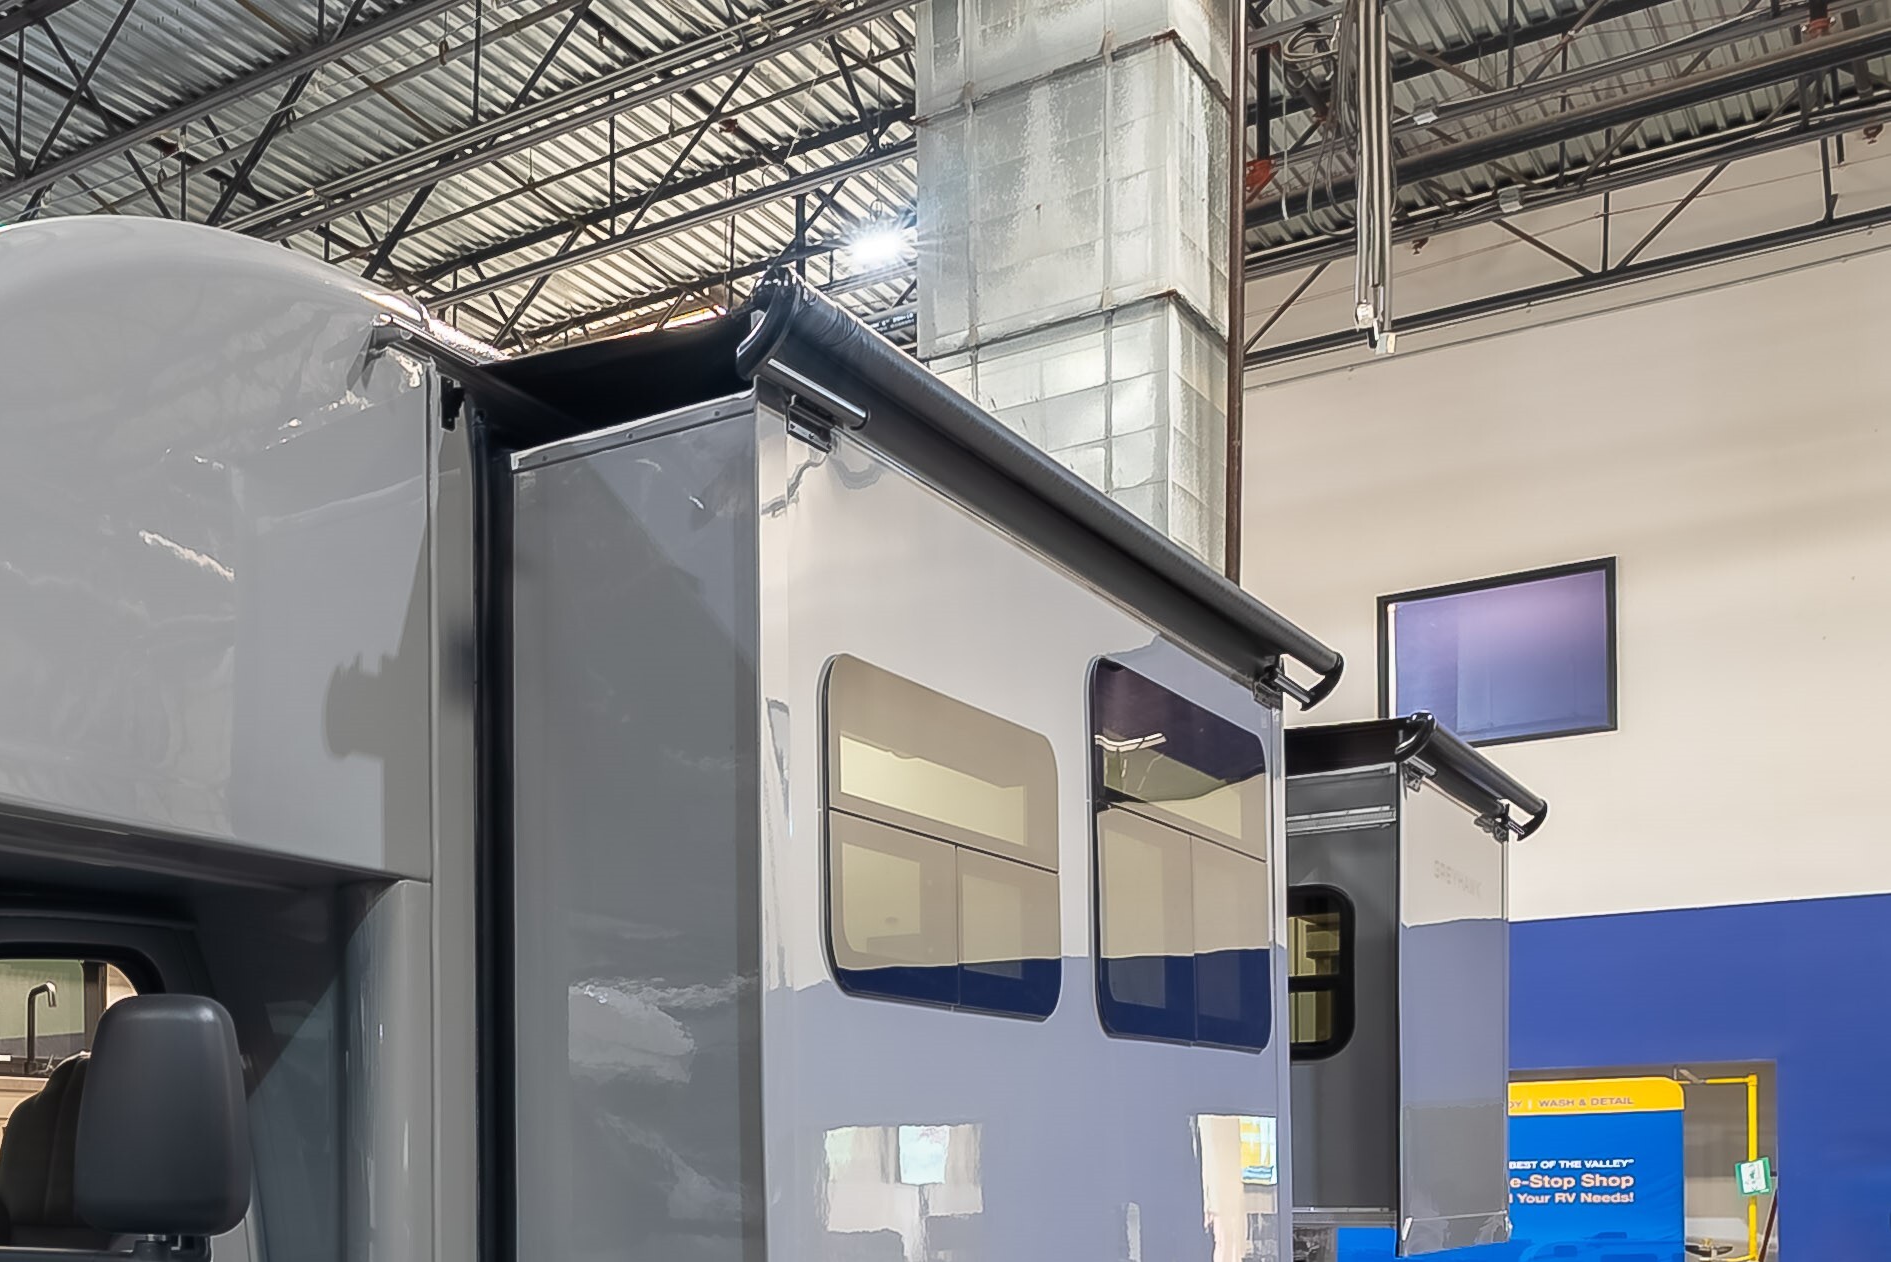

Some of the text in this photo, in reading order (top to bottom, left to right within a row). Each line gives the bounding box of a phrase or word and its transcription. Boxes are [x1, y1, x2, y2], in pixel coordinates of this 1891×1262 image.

[1538, 1099, 1575, 1108] WASH
[1578, 1098, 1586, 1107] &
[1590, 1097, 1634, 1107] DETAIL
[1540, 1160, 1556, 1169] OF
[1558, 1159, 1581, 1169] THE
[1509, 1173, 1635, 1190] e-Stop Shop
[1516, 1193, 1550, 1204] Your
[1554, 1193, 1577, 1203] RV
[1580, 1192, 1635, 1203] Needs!
